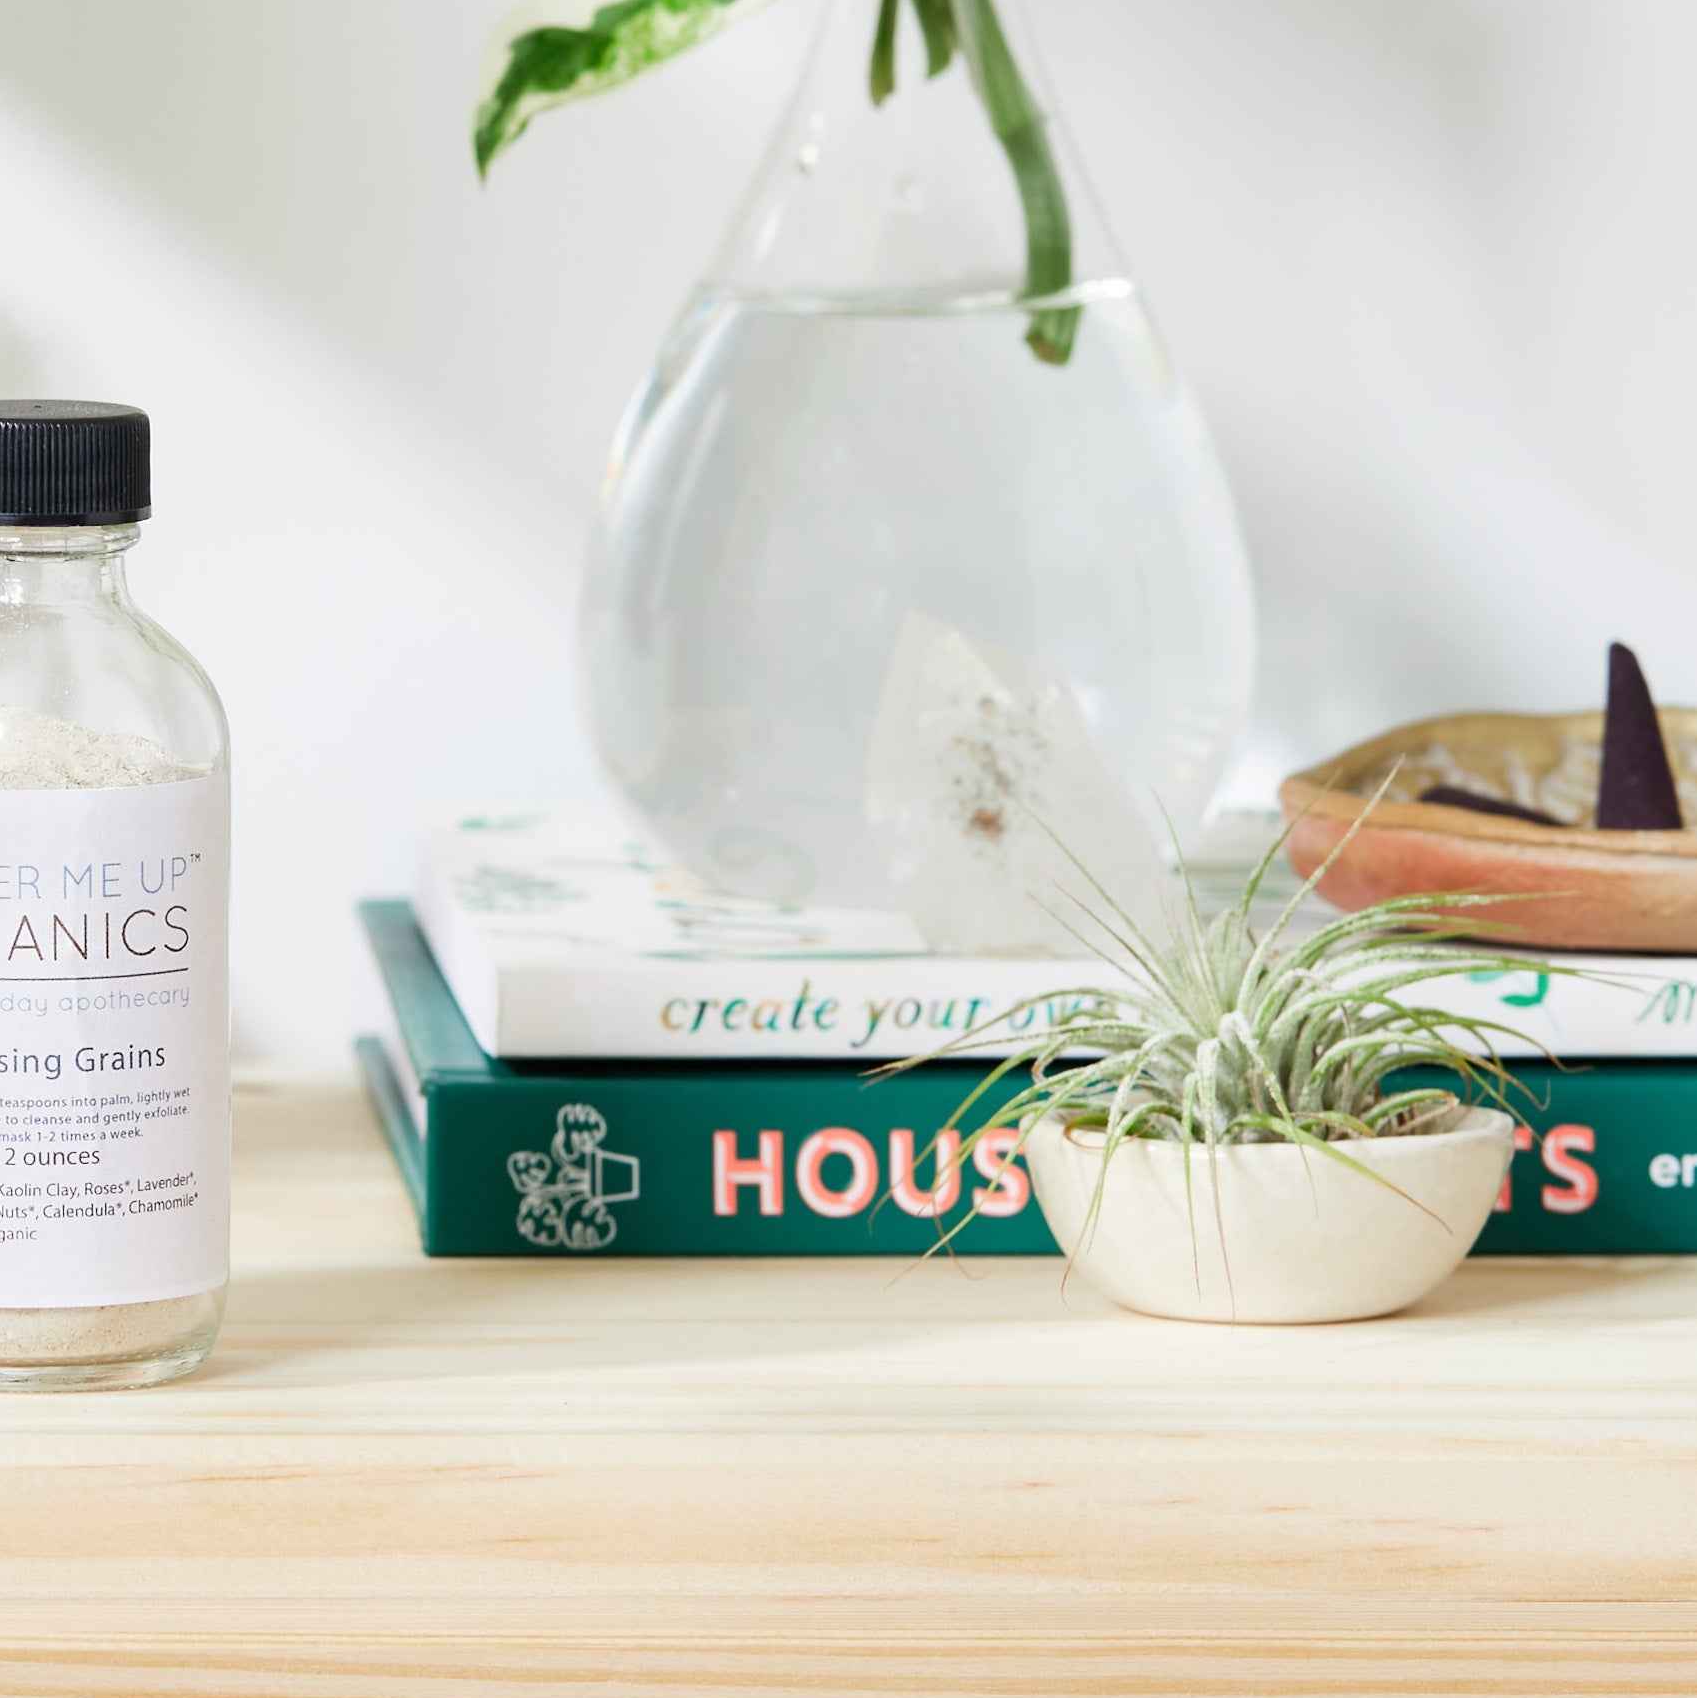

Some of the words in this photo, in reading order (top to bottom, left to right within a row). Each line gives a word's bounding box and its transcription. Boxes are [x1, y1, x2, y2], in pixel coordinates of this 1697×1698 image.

[63, 862, 122, 899] ME
[0, 993, 48, 1017] day
[59, 986, 190, 1014] apothecary
[660, 976, 840, 1035] create
[849, 994, 993, 1049] your
[75, 1043, 166, 1072] Grains
[0, 1097, 67, 1109] teaspoons
[71, 1096, 97, 1107] into
[100, 1094, 133, 1109] palm,
[136, 1089, 171, 1106] lightly
[173, 1087, 191, 1099] wet
[5, 1115, 19, 1126] to
[23, 1114, 72, 1126] cleanse
[76, 1113, 99, 1125] and
[103, 1110, 141, 1126] gently
[37, 1130, 56, 1143] 1-2
[61, 1130, 96, 1142] times
[110, 1126, 144, 1140] week.
[4, 1147, 17, 1166] 2
[23, 1149, 100, 1166] ounces
[713, 1127, 1031, 1218] HOUS
[46, 1182, 81, 1200] Clay,
